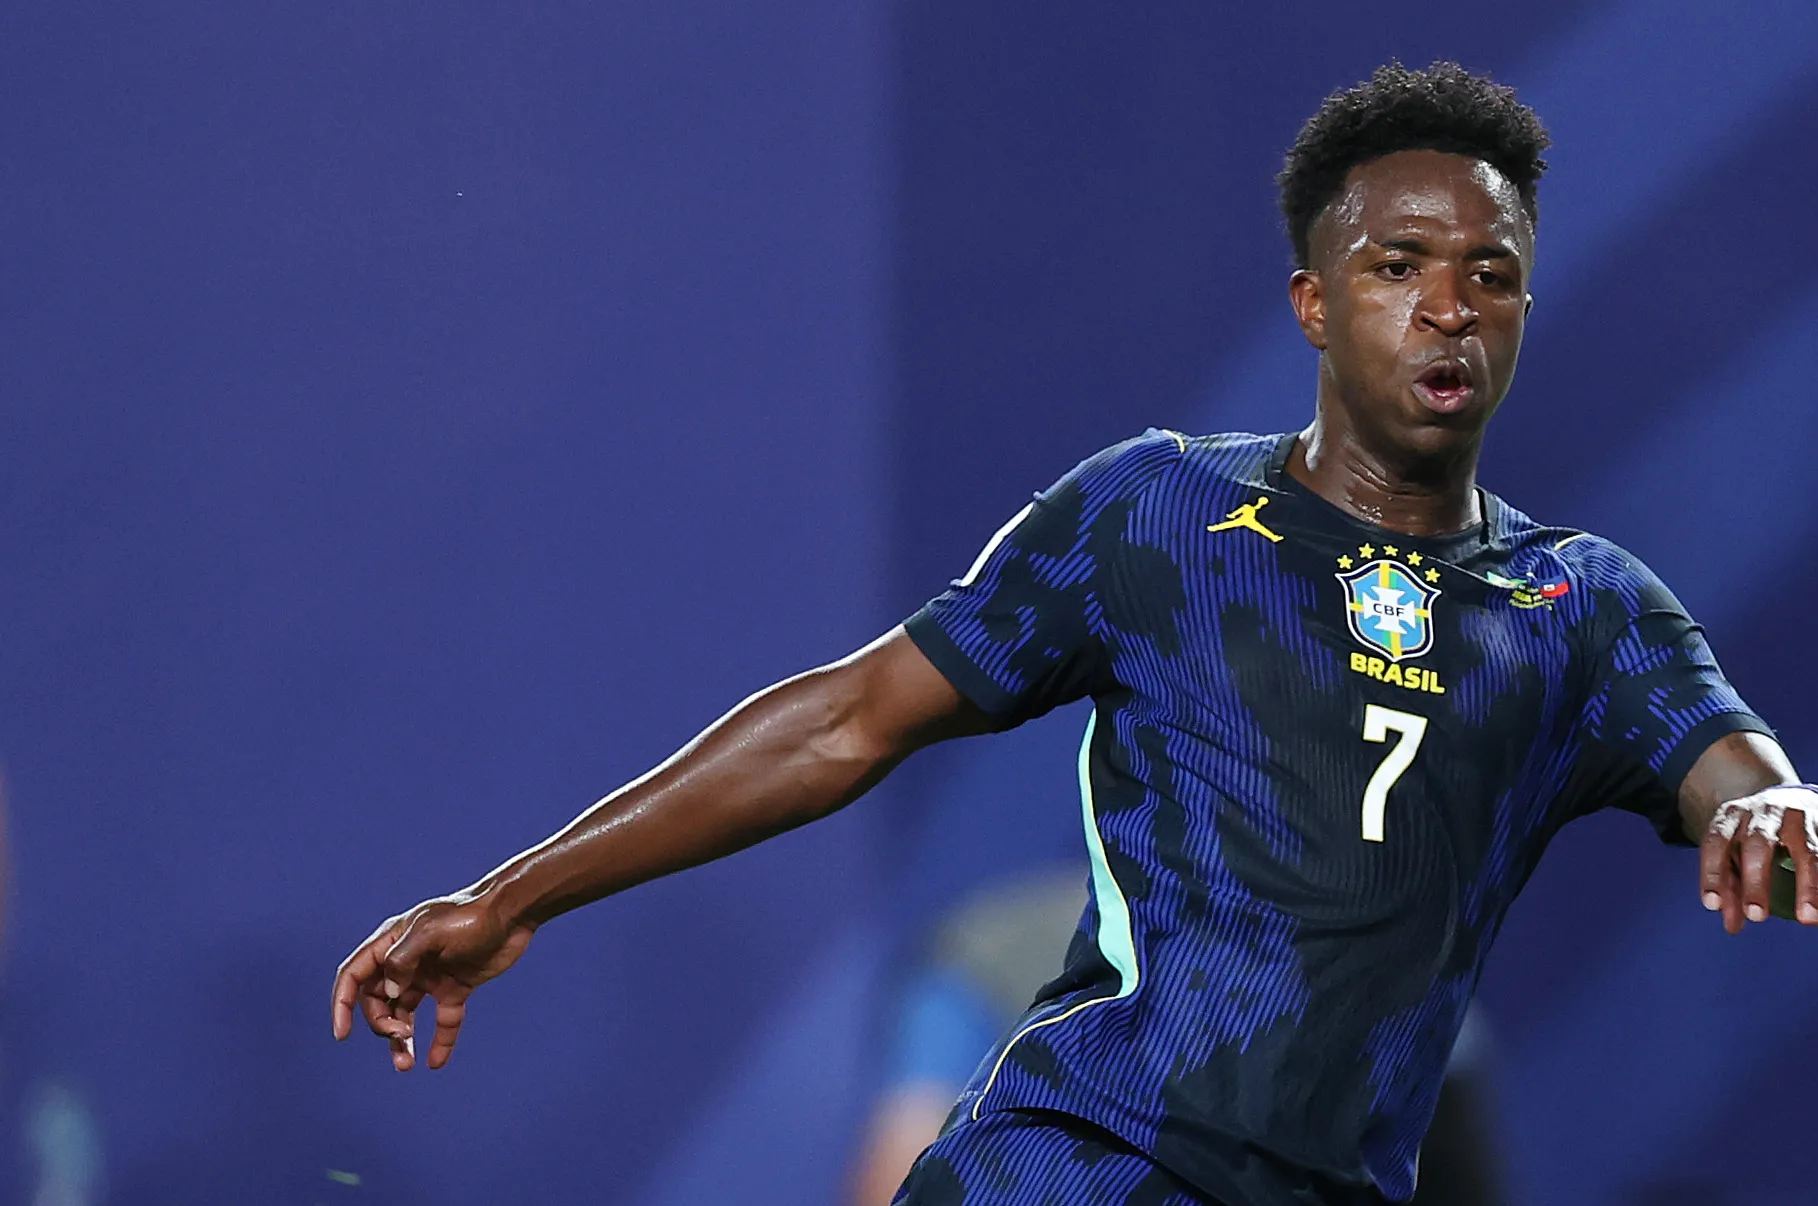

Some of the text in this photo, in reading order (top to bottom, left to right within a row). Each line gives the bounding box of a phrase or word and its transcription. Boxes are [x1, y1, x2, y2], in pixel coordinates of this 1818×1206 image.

[1372, 603, 1405, 617] CBF
[1350, 652, 1446, 694] BRASIL
[1362, 703, 1428, 842] 7
